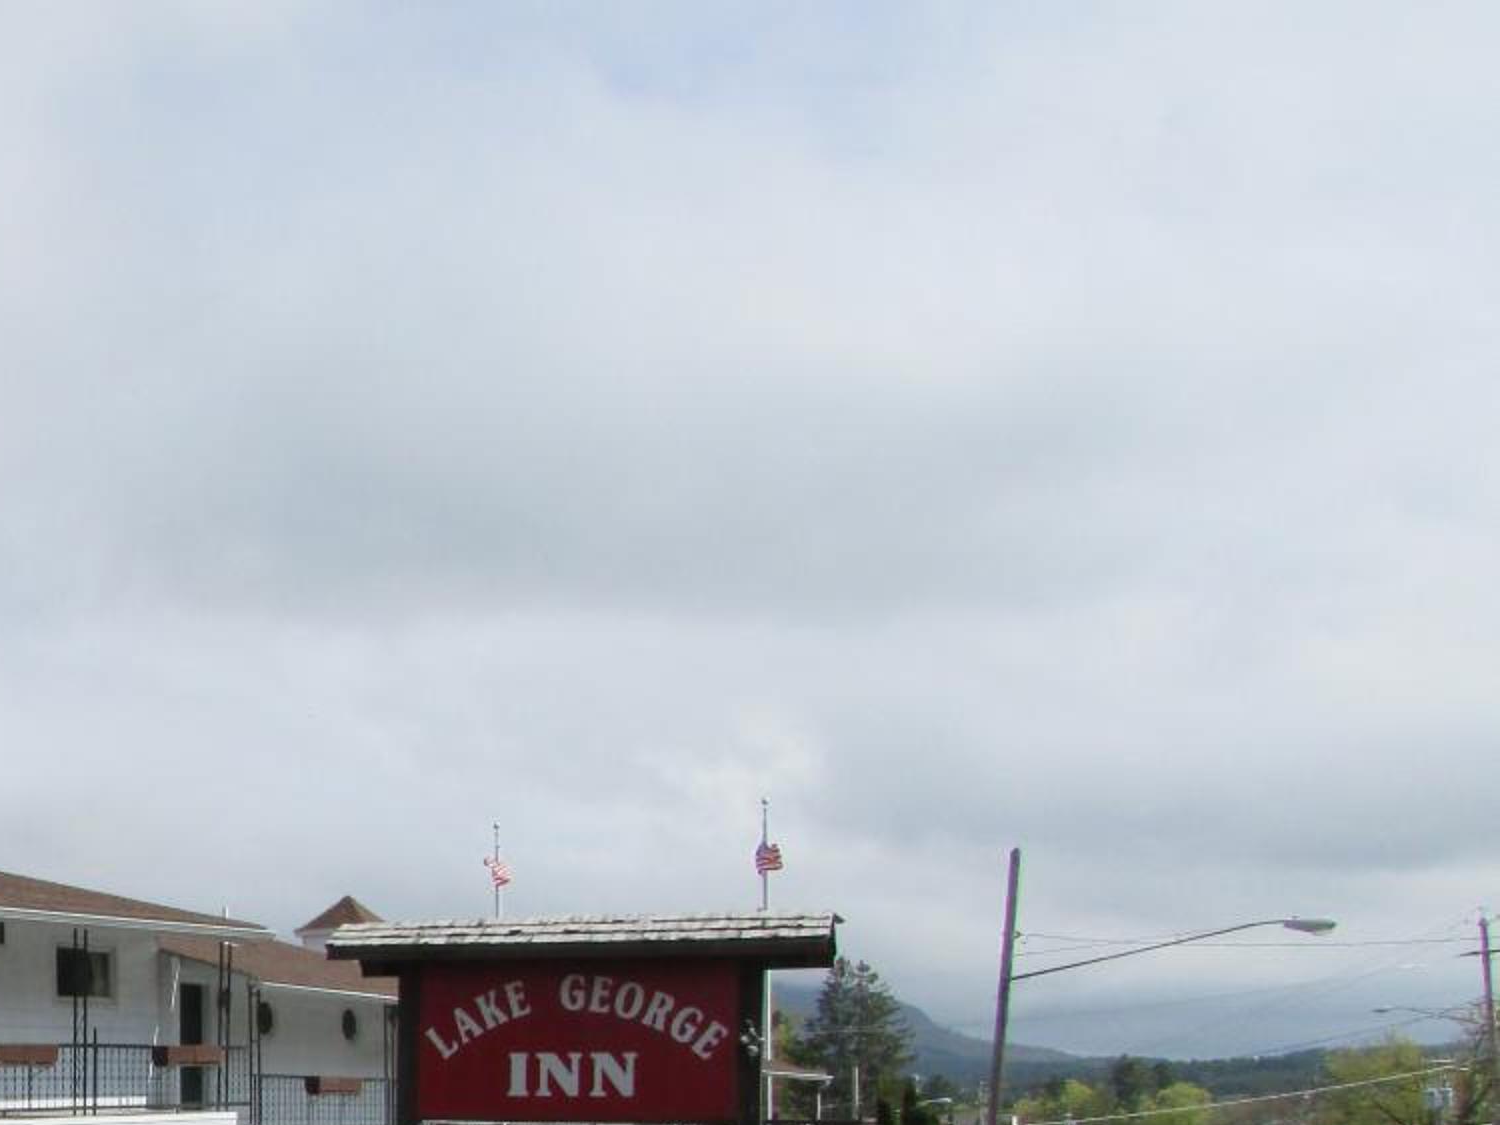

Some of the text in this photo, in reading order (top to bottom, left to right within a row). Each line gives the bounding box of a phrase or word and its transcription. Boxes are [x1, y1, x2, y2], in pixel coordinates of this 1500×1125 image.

[424, 975, 729, 1060] LAKE GEORGE
[507, 1052, 638, 1097] INN
